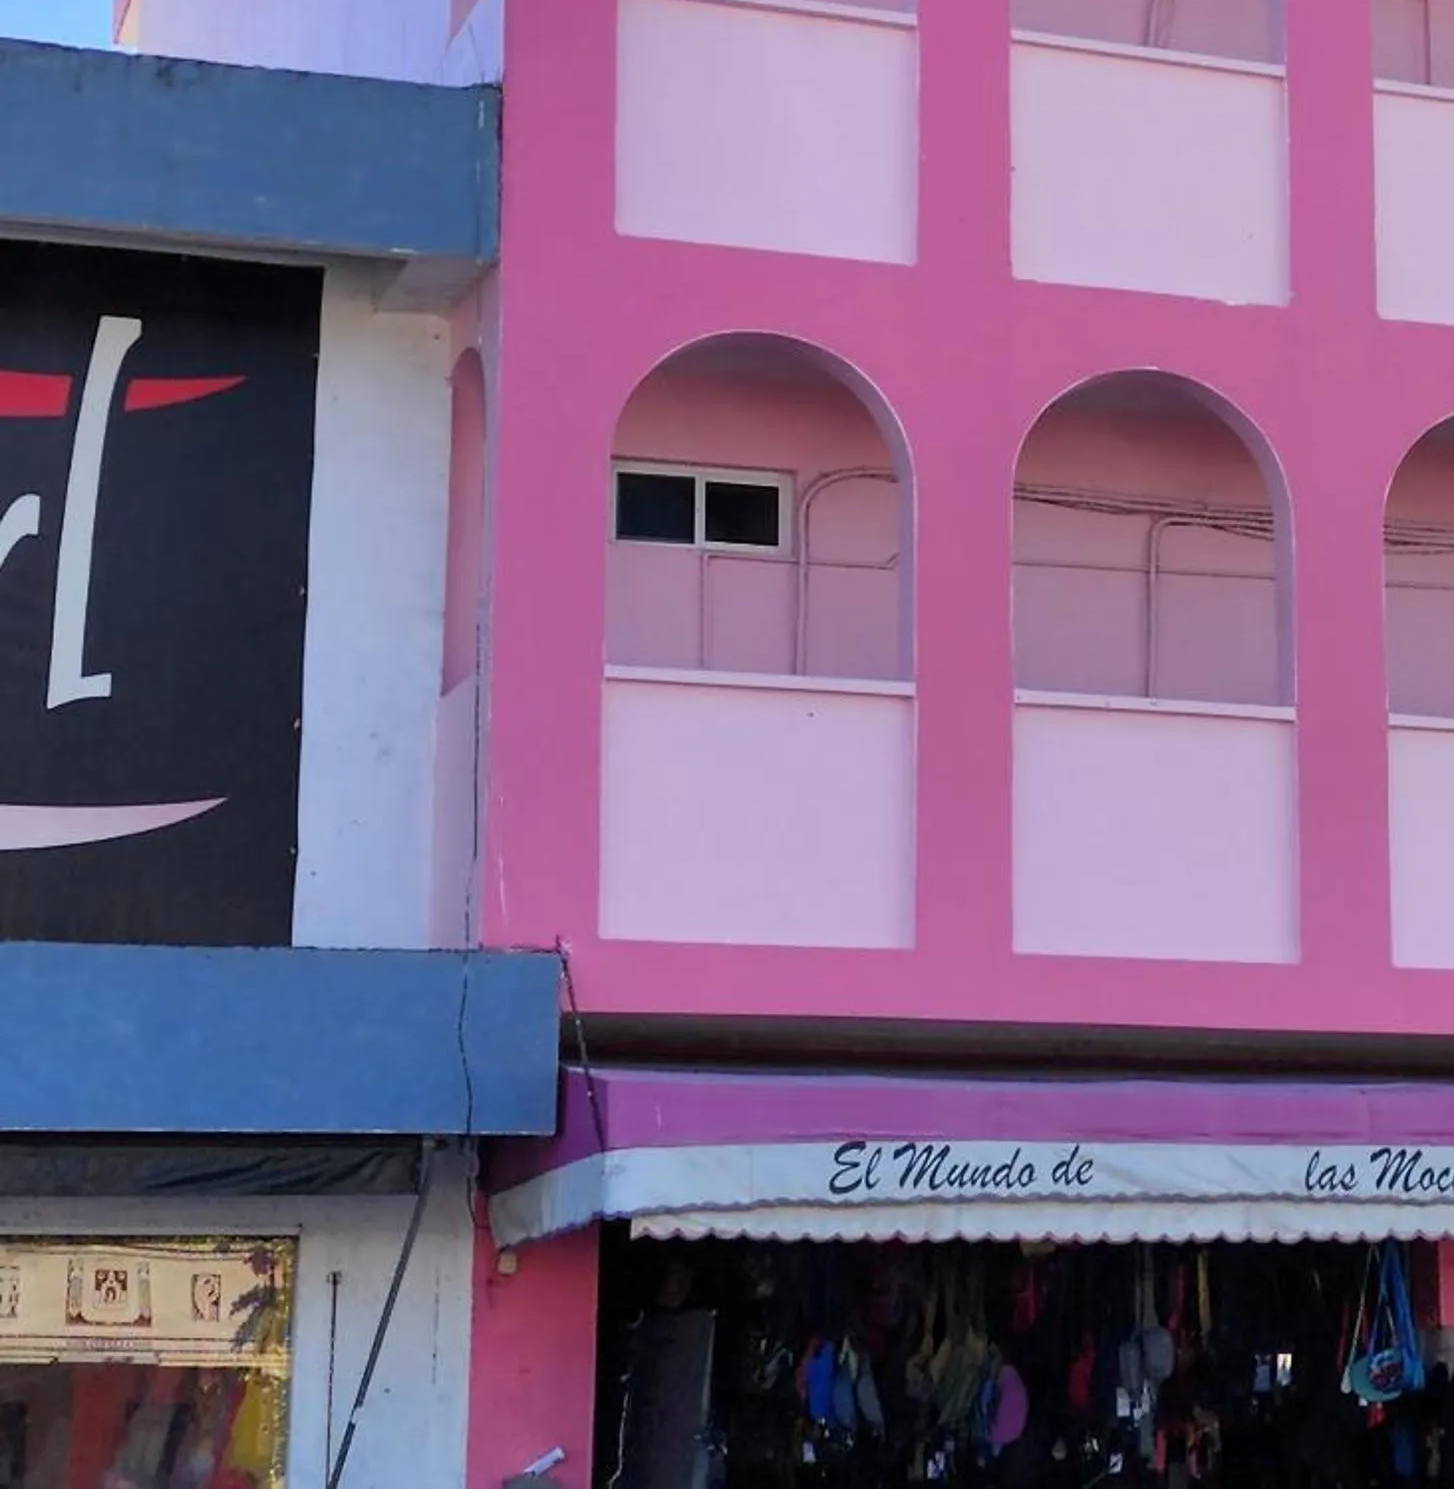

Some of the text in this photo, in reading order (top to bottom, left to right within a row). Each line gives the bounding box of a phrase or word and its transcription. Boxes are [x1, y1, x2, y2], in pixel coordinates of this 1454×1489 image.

[829, 1140, 882, 1194] El
[893, 1142, 1037, 1190] Mundo
[1052, 1144, 1094, 1186] de
[1304, 1149, 1358, 1192] las
